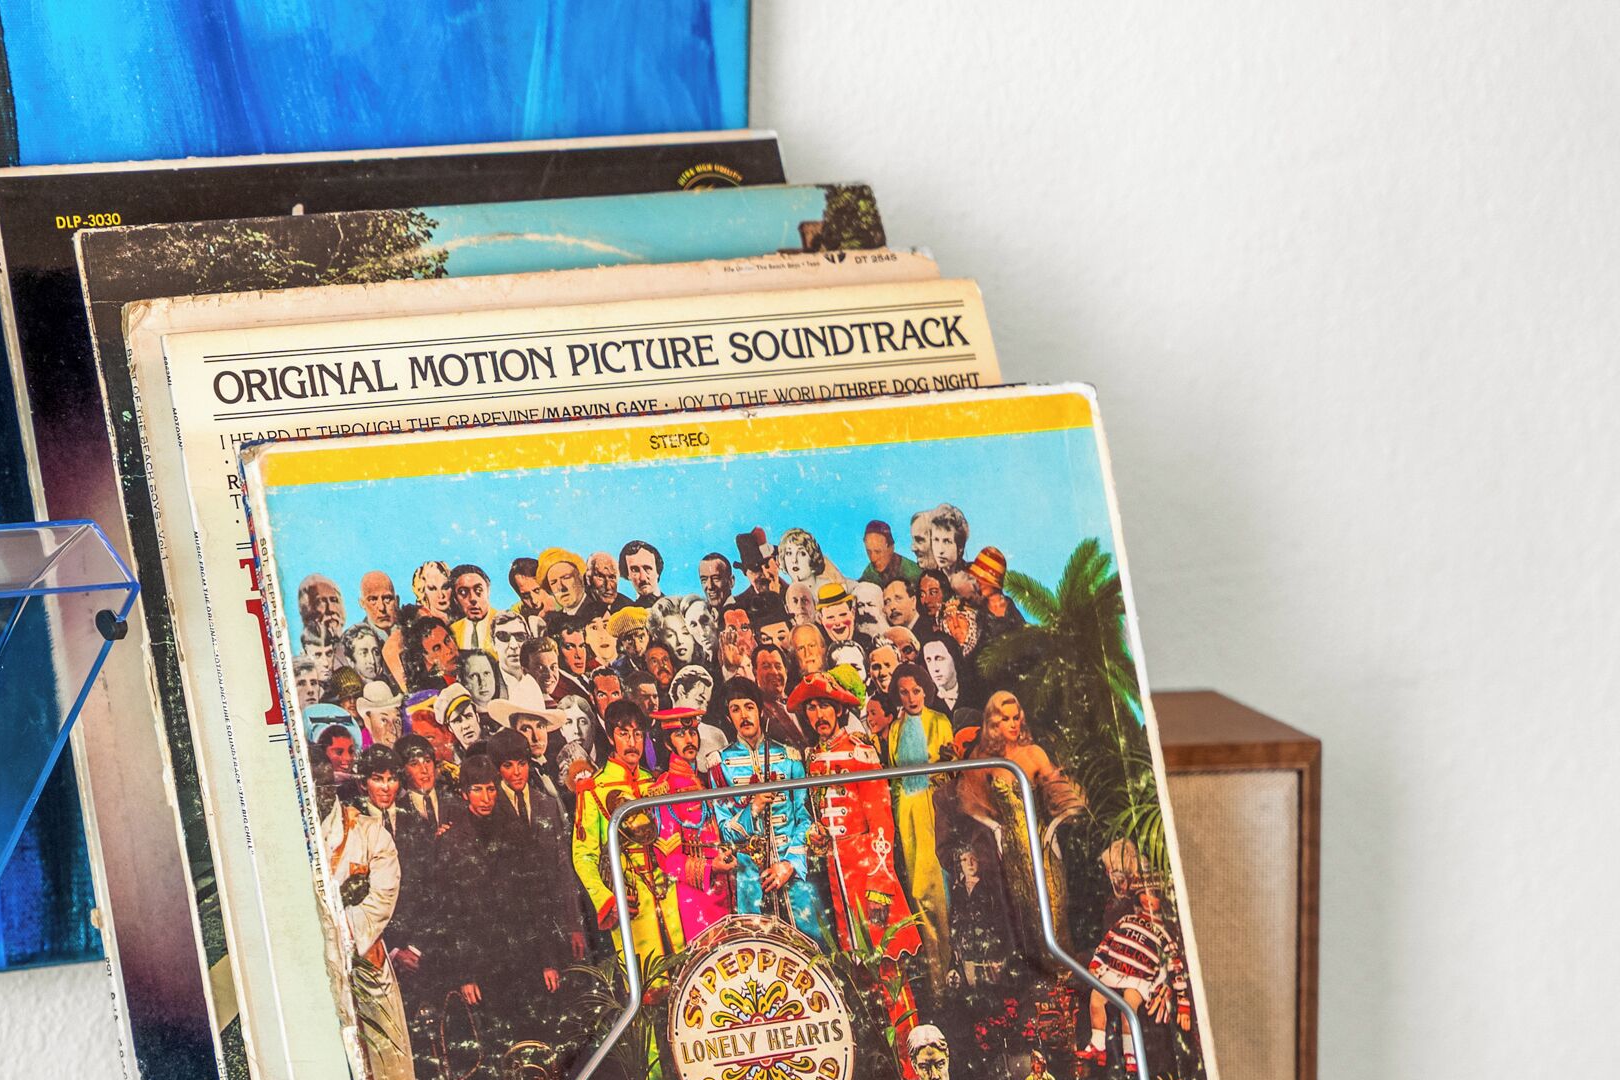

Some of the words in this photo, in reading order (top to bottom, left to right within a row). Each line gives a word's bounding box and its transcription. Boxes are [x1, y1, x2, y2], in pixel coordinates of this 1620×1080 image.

[55, 212, 122, 230] DLP-3030
[212, 359, 399, 405] ORIGINAL
[409, 346, 558, 390] MOTION
[567, 334, 720, 377] PICTURE
[729, 315, 971, 362] SOUNDTRACK
[892, 376, 930, 394] DOG
[931, 372, 980, 391] NIGHT
[649, 431, 710, 450] STEREO
[297, 758, 309, 794] CLUB
[304, 797, 316, 836] BAND
[1125, 928, 1148, 945] THE
[699, 947, 830, 1013] PEPPERS
[680, 1031, 757, 1065] LONELY
[766, 1018, 844, 1051] HEARTS
